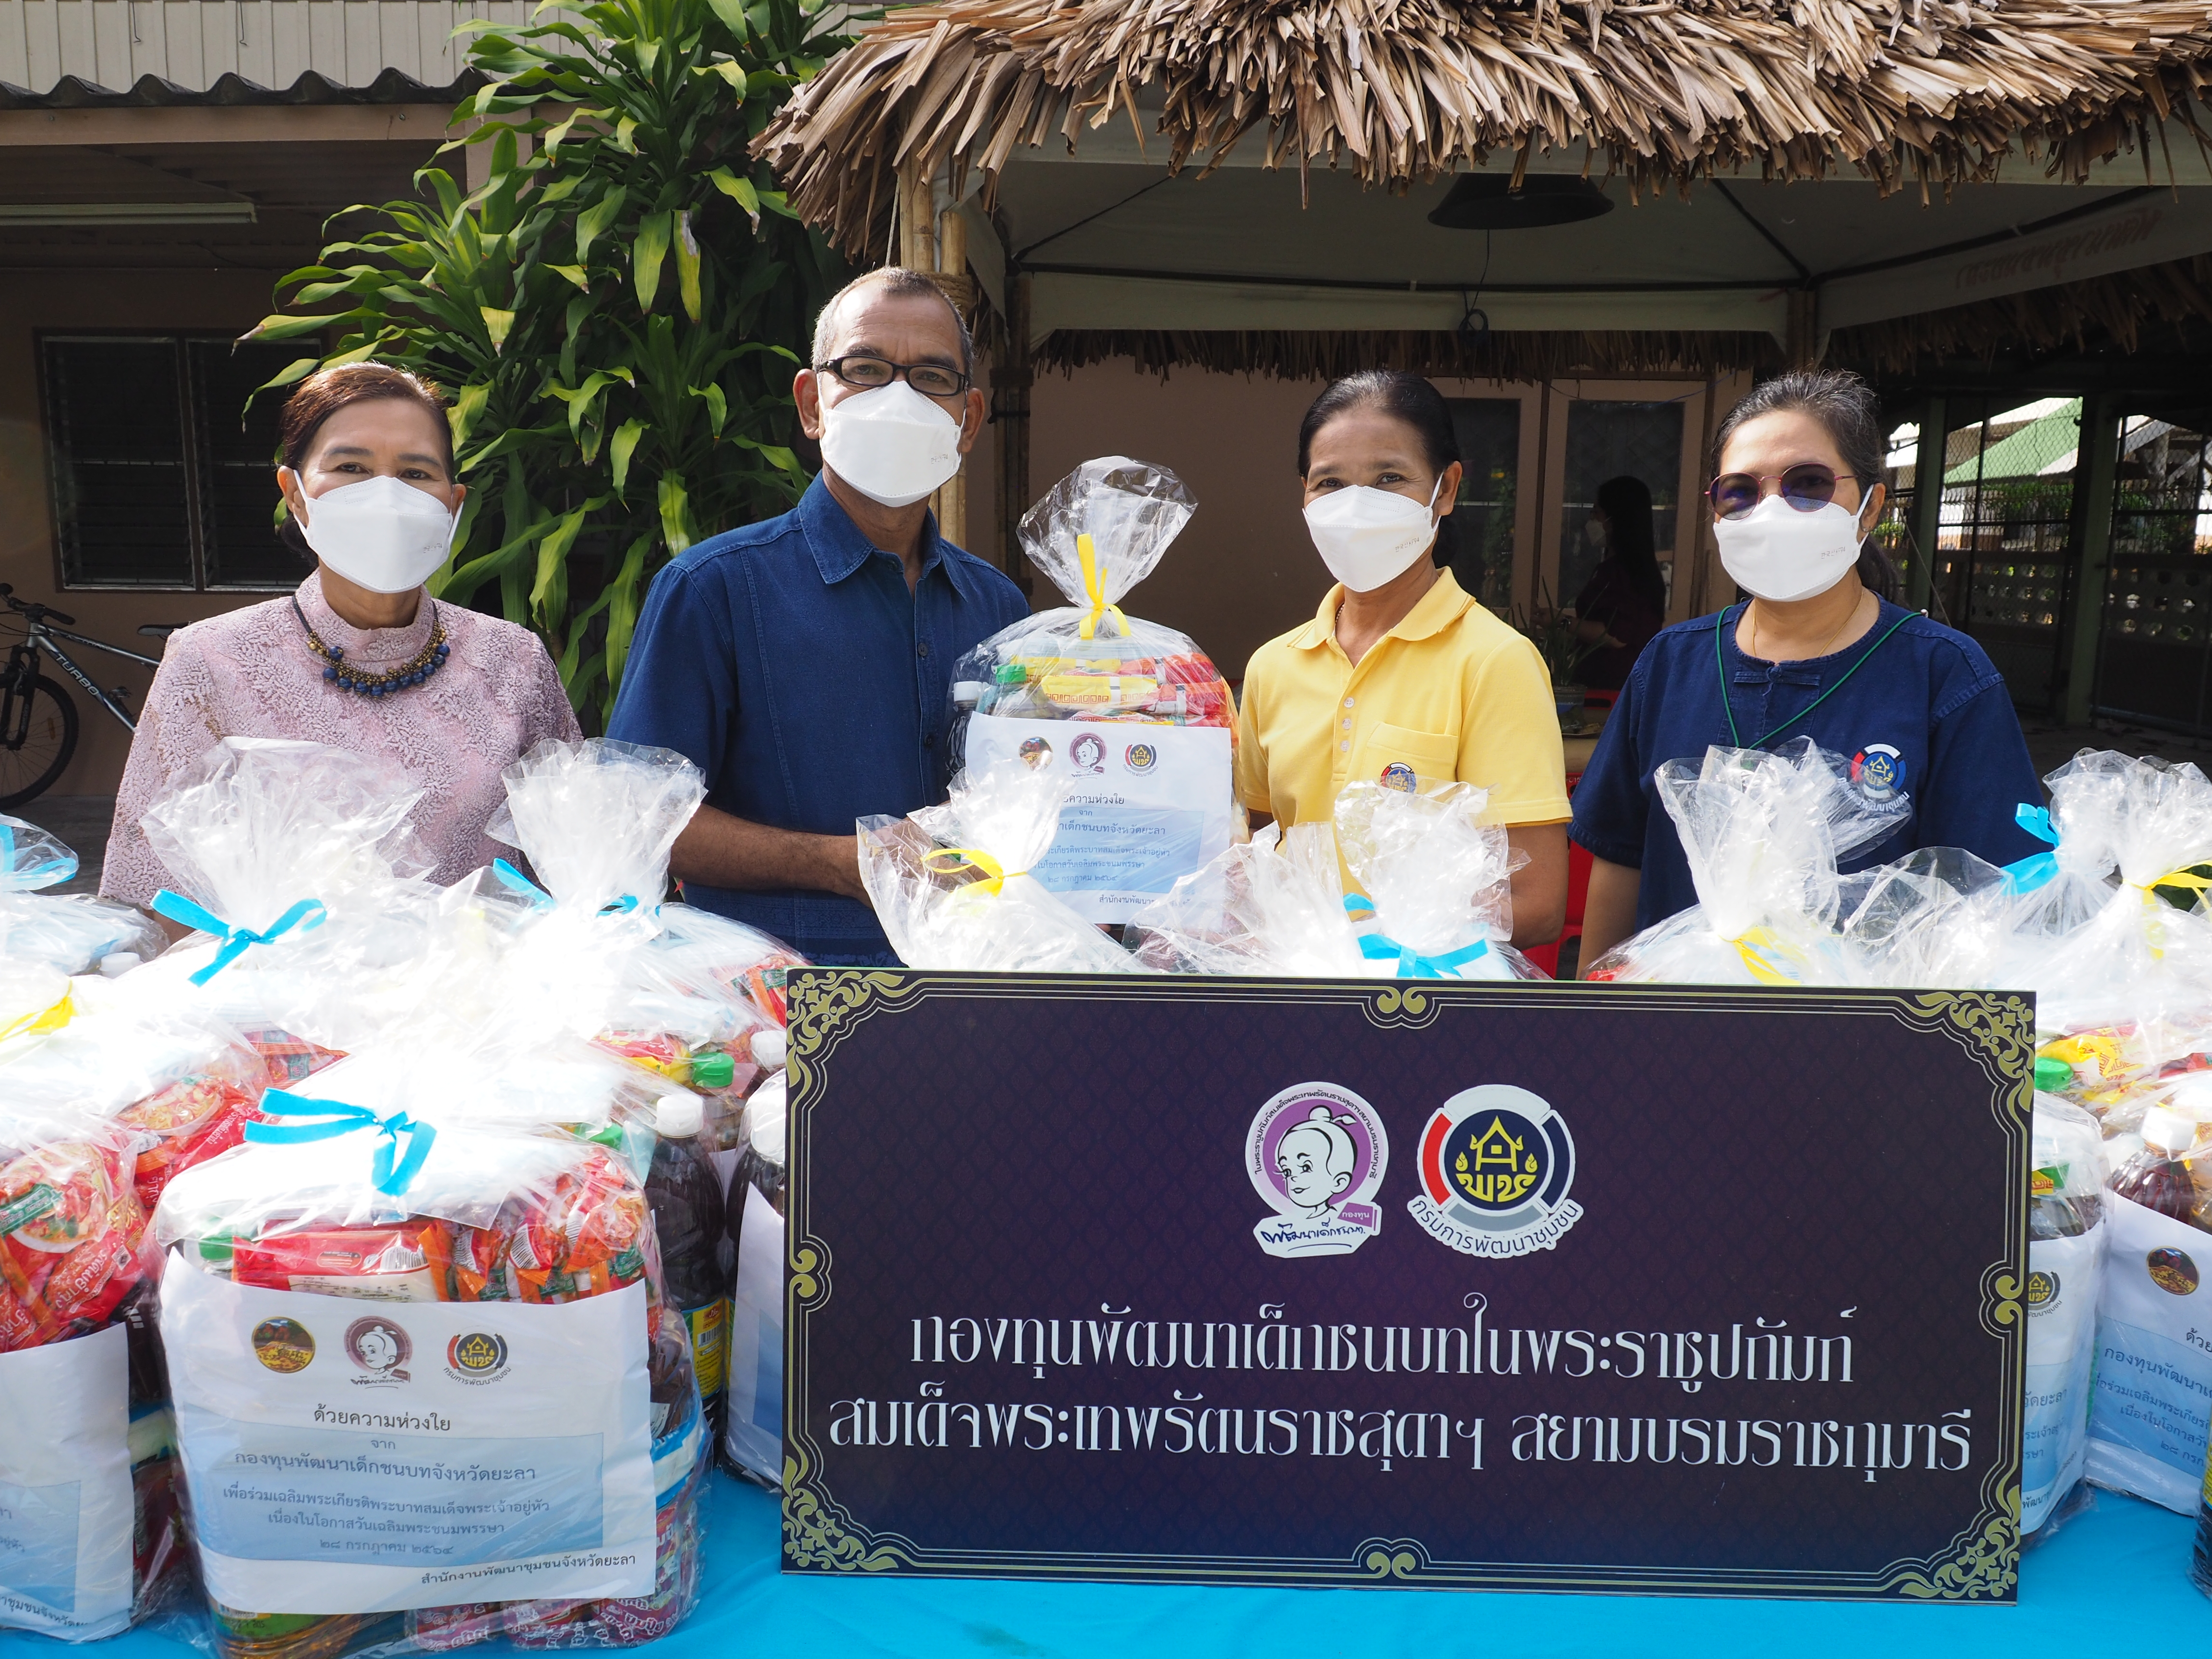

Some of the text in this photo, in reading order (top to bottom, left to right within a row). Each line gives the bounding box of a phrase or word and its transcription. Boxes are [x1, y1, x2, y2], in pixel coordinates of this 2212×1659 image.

[56, 653, 99, 695] TURBO
[1057, 819, 1166, 835] าเด็กชนบทจังหวัดยะลา
[1342, 1211, 1370, 1220] กองทุน
[1411, 1199, 1579, 1255] กรมการพัฒนาชุมชน
[910, 1291, 1858, 1394] กองทุนพัฒนาเด็กชนบทในพระราชูปถัมภ์
[443, 1367, 512, 1386] กรมการพัฒนาชุมชน
[314, 1403, 451, 1431] ด้วยความห่วงใย
[371, 1440, 396, 1450] จาก
[830, 1380, 1972, 1483] สมเด็จพระเทพรัตนราชสุดาฯ สยามบรมราชกุมารี
[235, 1453, 536, 1481] กองทุนพัฒนาเด็กชนบทจังหวัดยะลา
[2182, 1451, 2204, 1467] กรก
[223, 1481, 550, 1516] เพื่อร่วมเฉลิมพระเกียรติพระบาทสมเด็จพระเจ้าอยู่หัว
[268, 1508, 505, 1535] เนื่องในโอกาสวันเฉลิมพระชนมพรรษา
[320, 1539, 454, 1555] ๒๘ กรกฎาคม ๒๕๖๔
[421, 1553, 637, 1584] สำนักงานพัฒนาชุมชนจังหวัดยะลา
